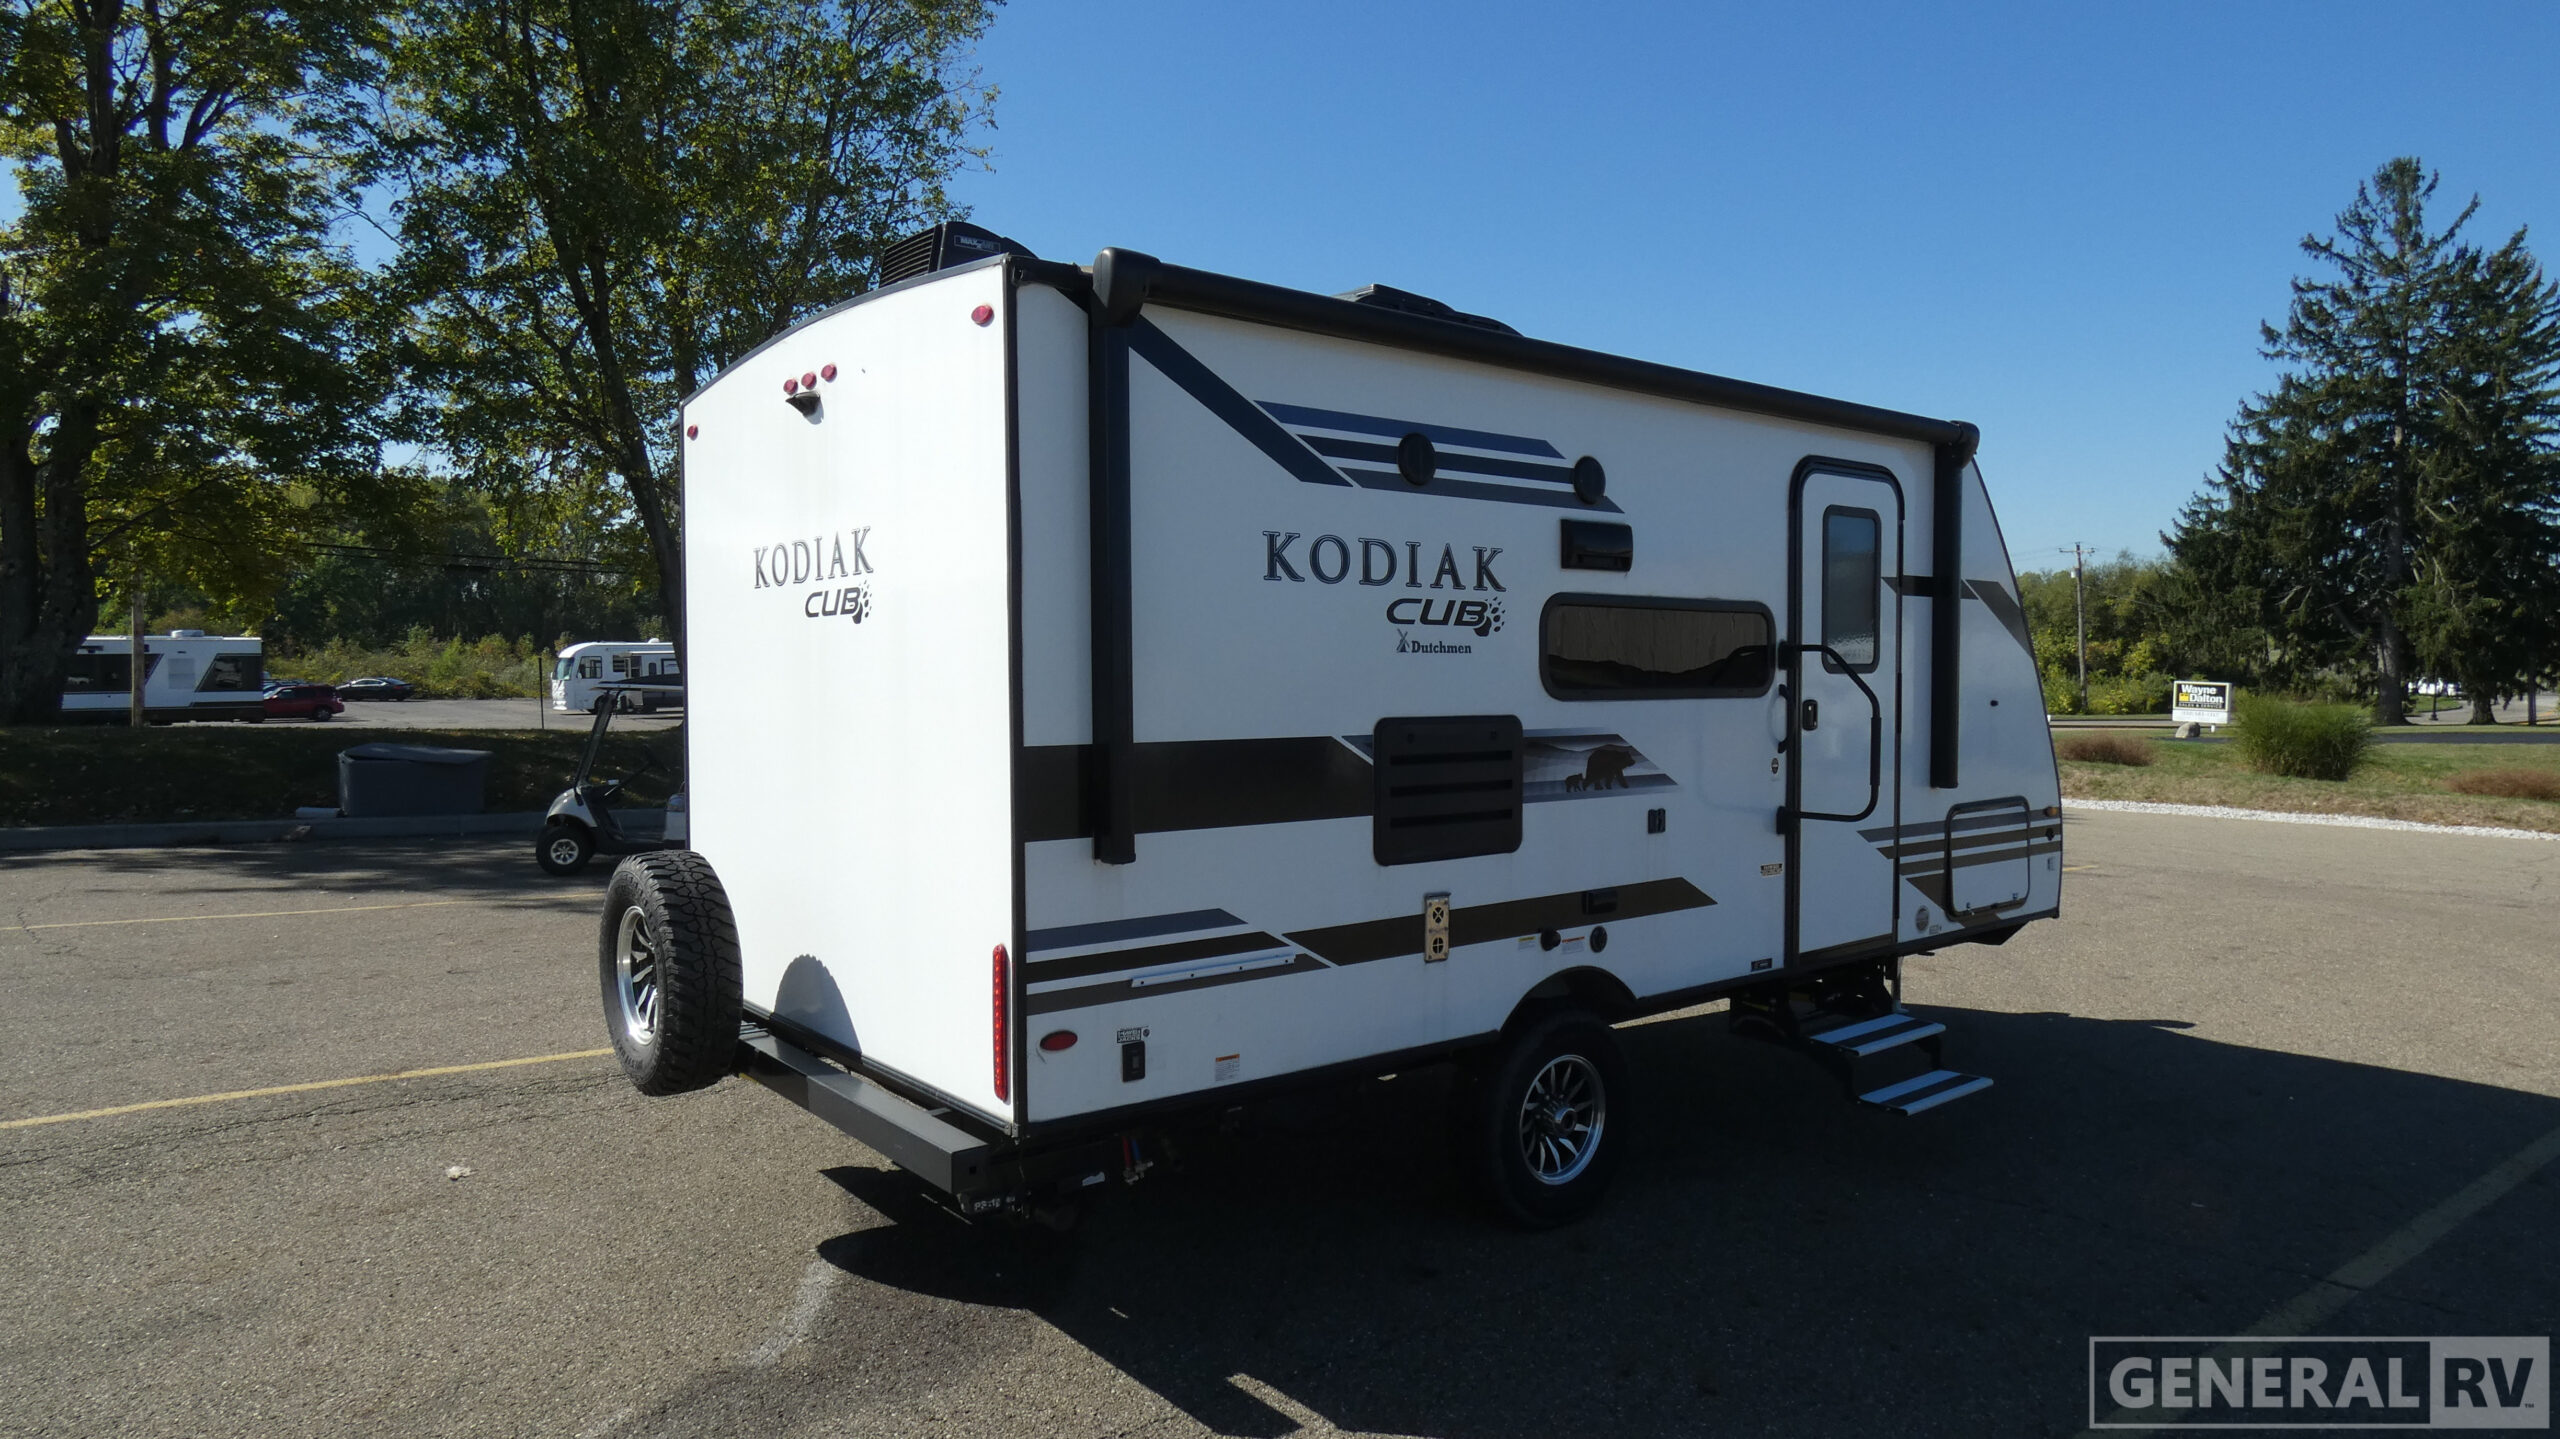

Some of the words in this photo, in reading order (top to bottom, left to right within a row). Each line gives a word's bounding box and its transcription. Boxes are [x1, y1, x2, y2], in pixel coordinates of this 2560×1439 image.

[753, 526, 874, 589] KODIAK
[1262, 531, 1506, 592] KODIAK
[805, 587, 861, 618] CUB
[1386, 598, 1488, 626] CUB
[1411, 640, 1472, 654] Dutchmen
[2181, 684, 2217, 695] Wayne
